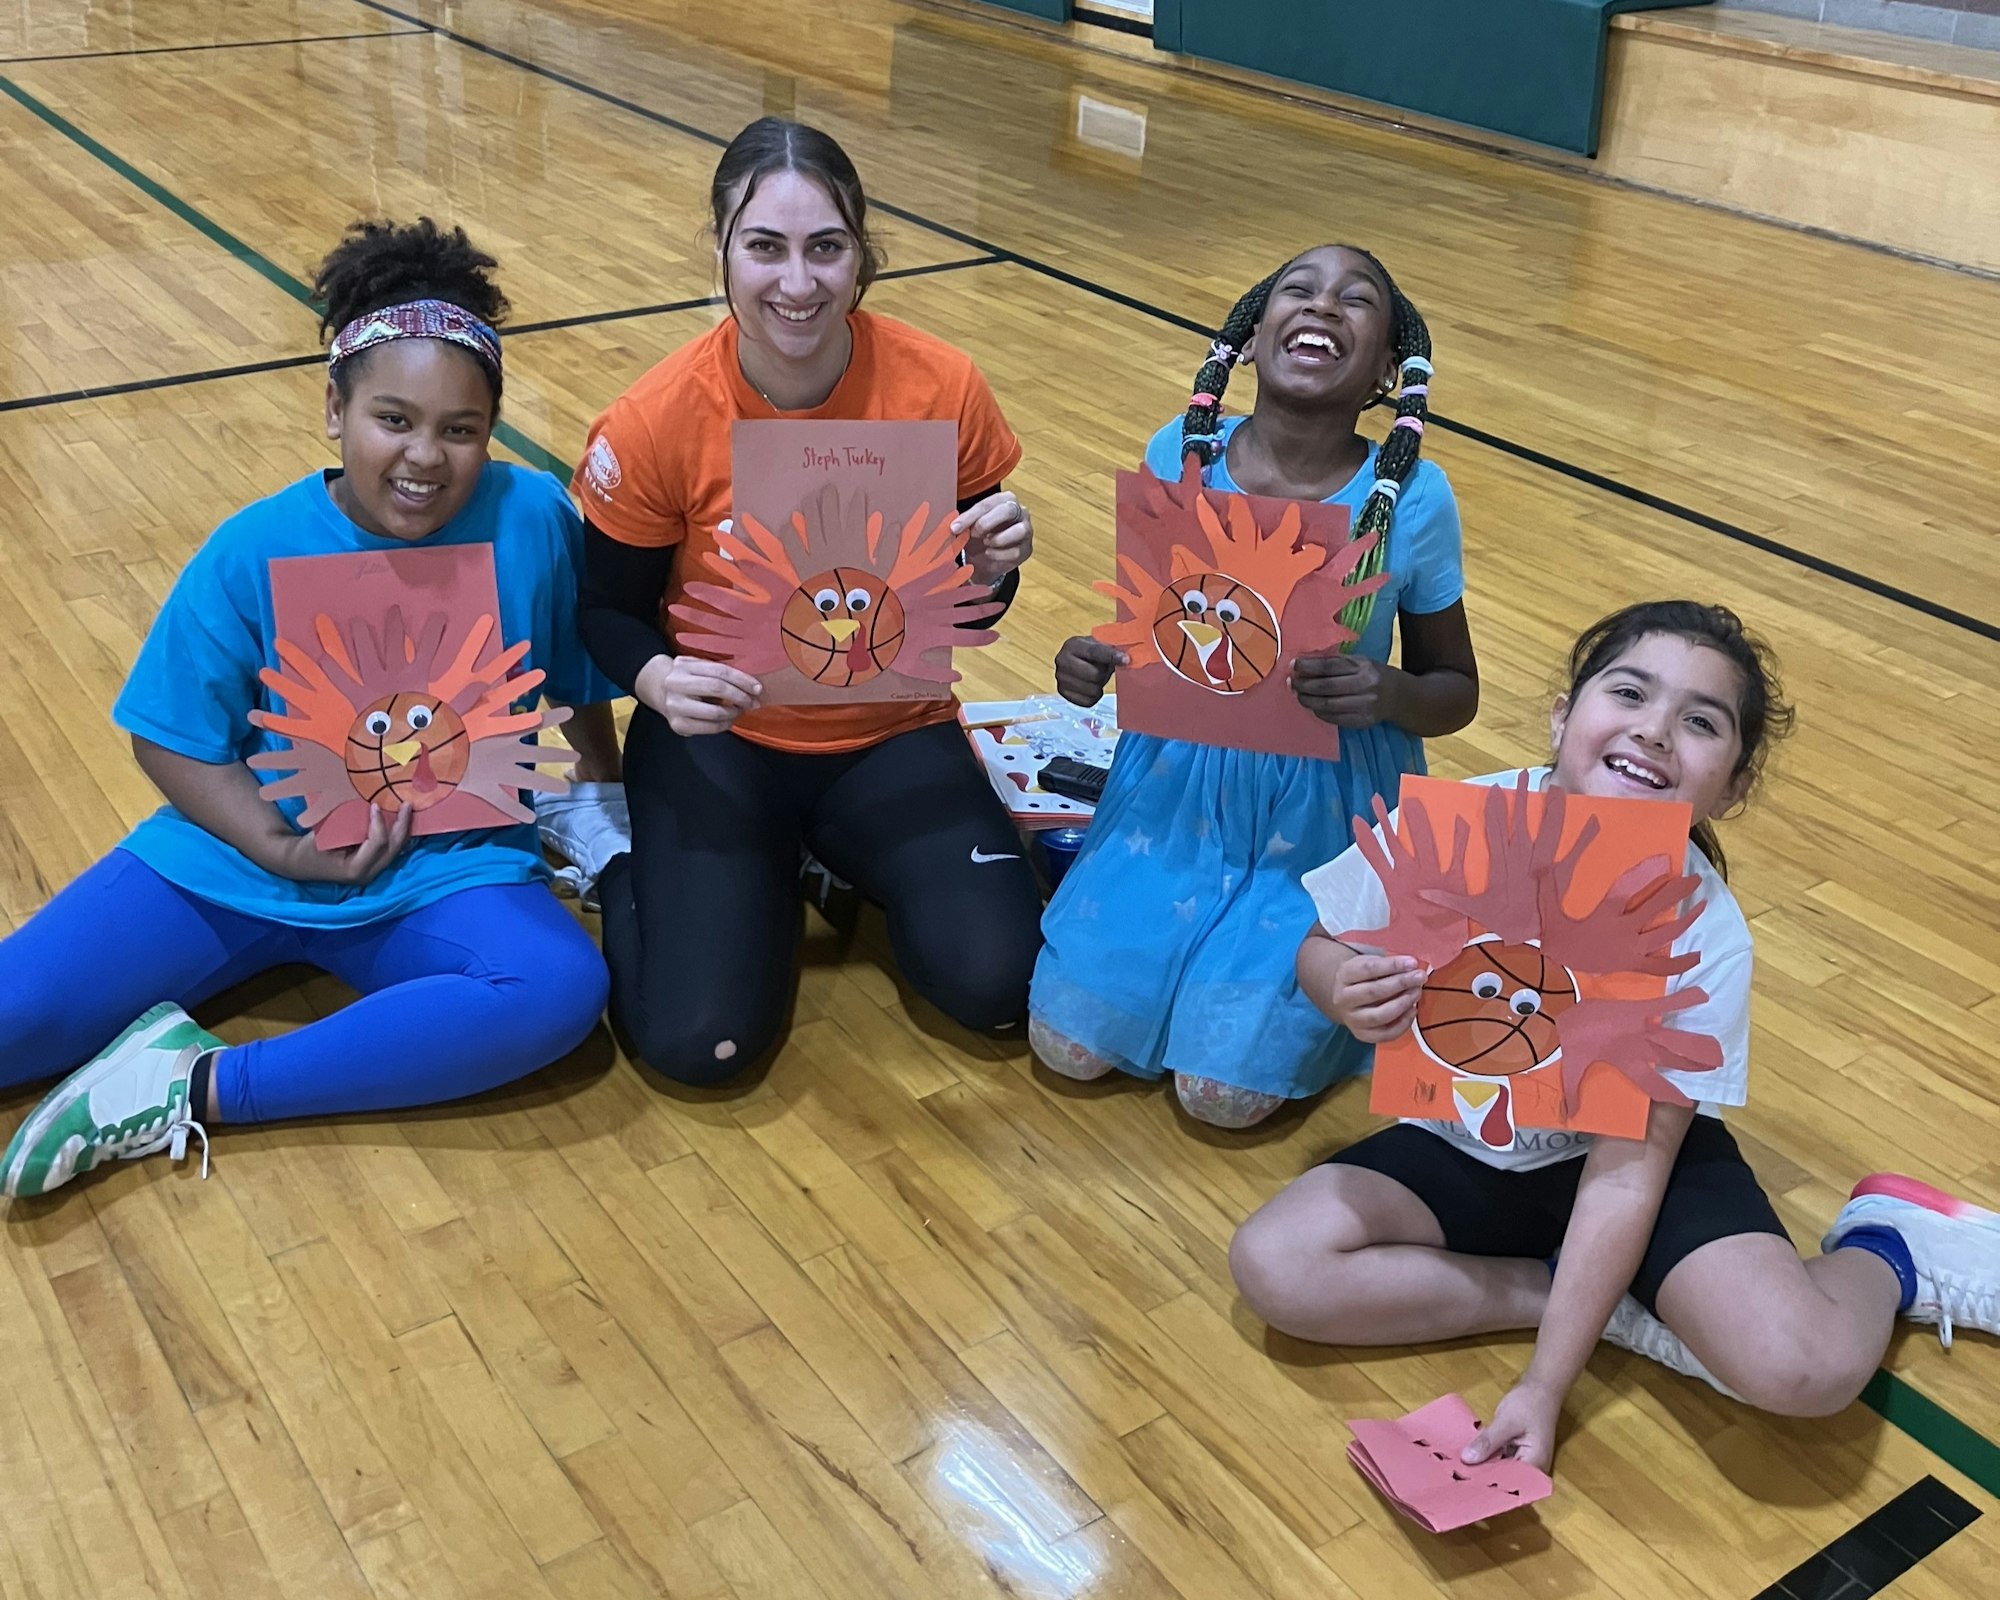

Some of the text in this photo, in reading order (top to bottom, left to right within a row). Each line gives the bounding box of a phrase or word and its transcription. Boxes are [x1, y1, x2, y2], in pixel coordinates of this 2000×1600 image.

[803, 446, 886, 476] Steph Turkey
[585, 466, 613, 502] STAFF
